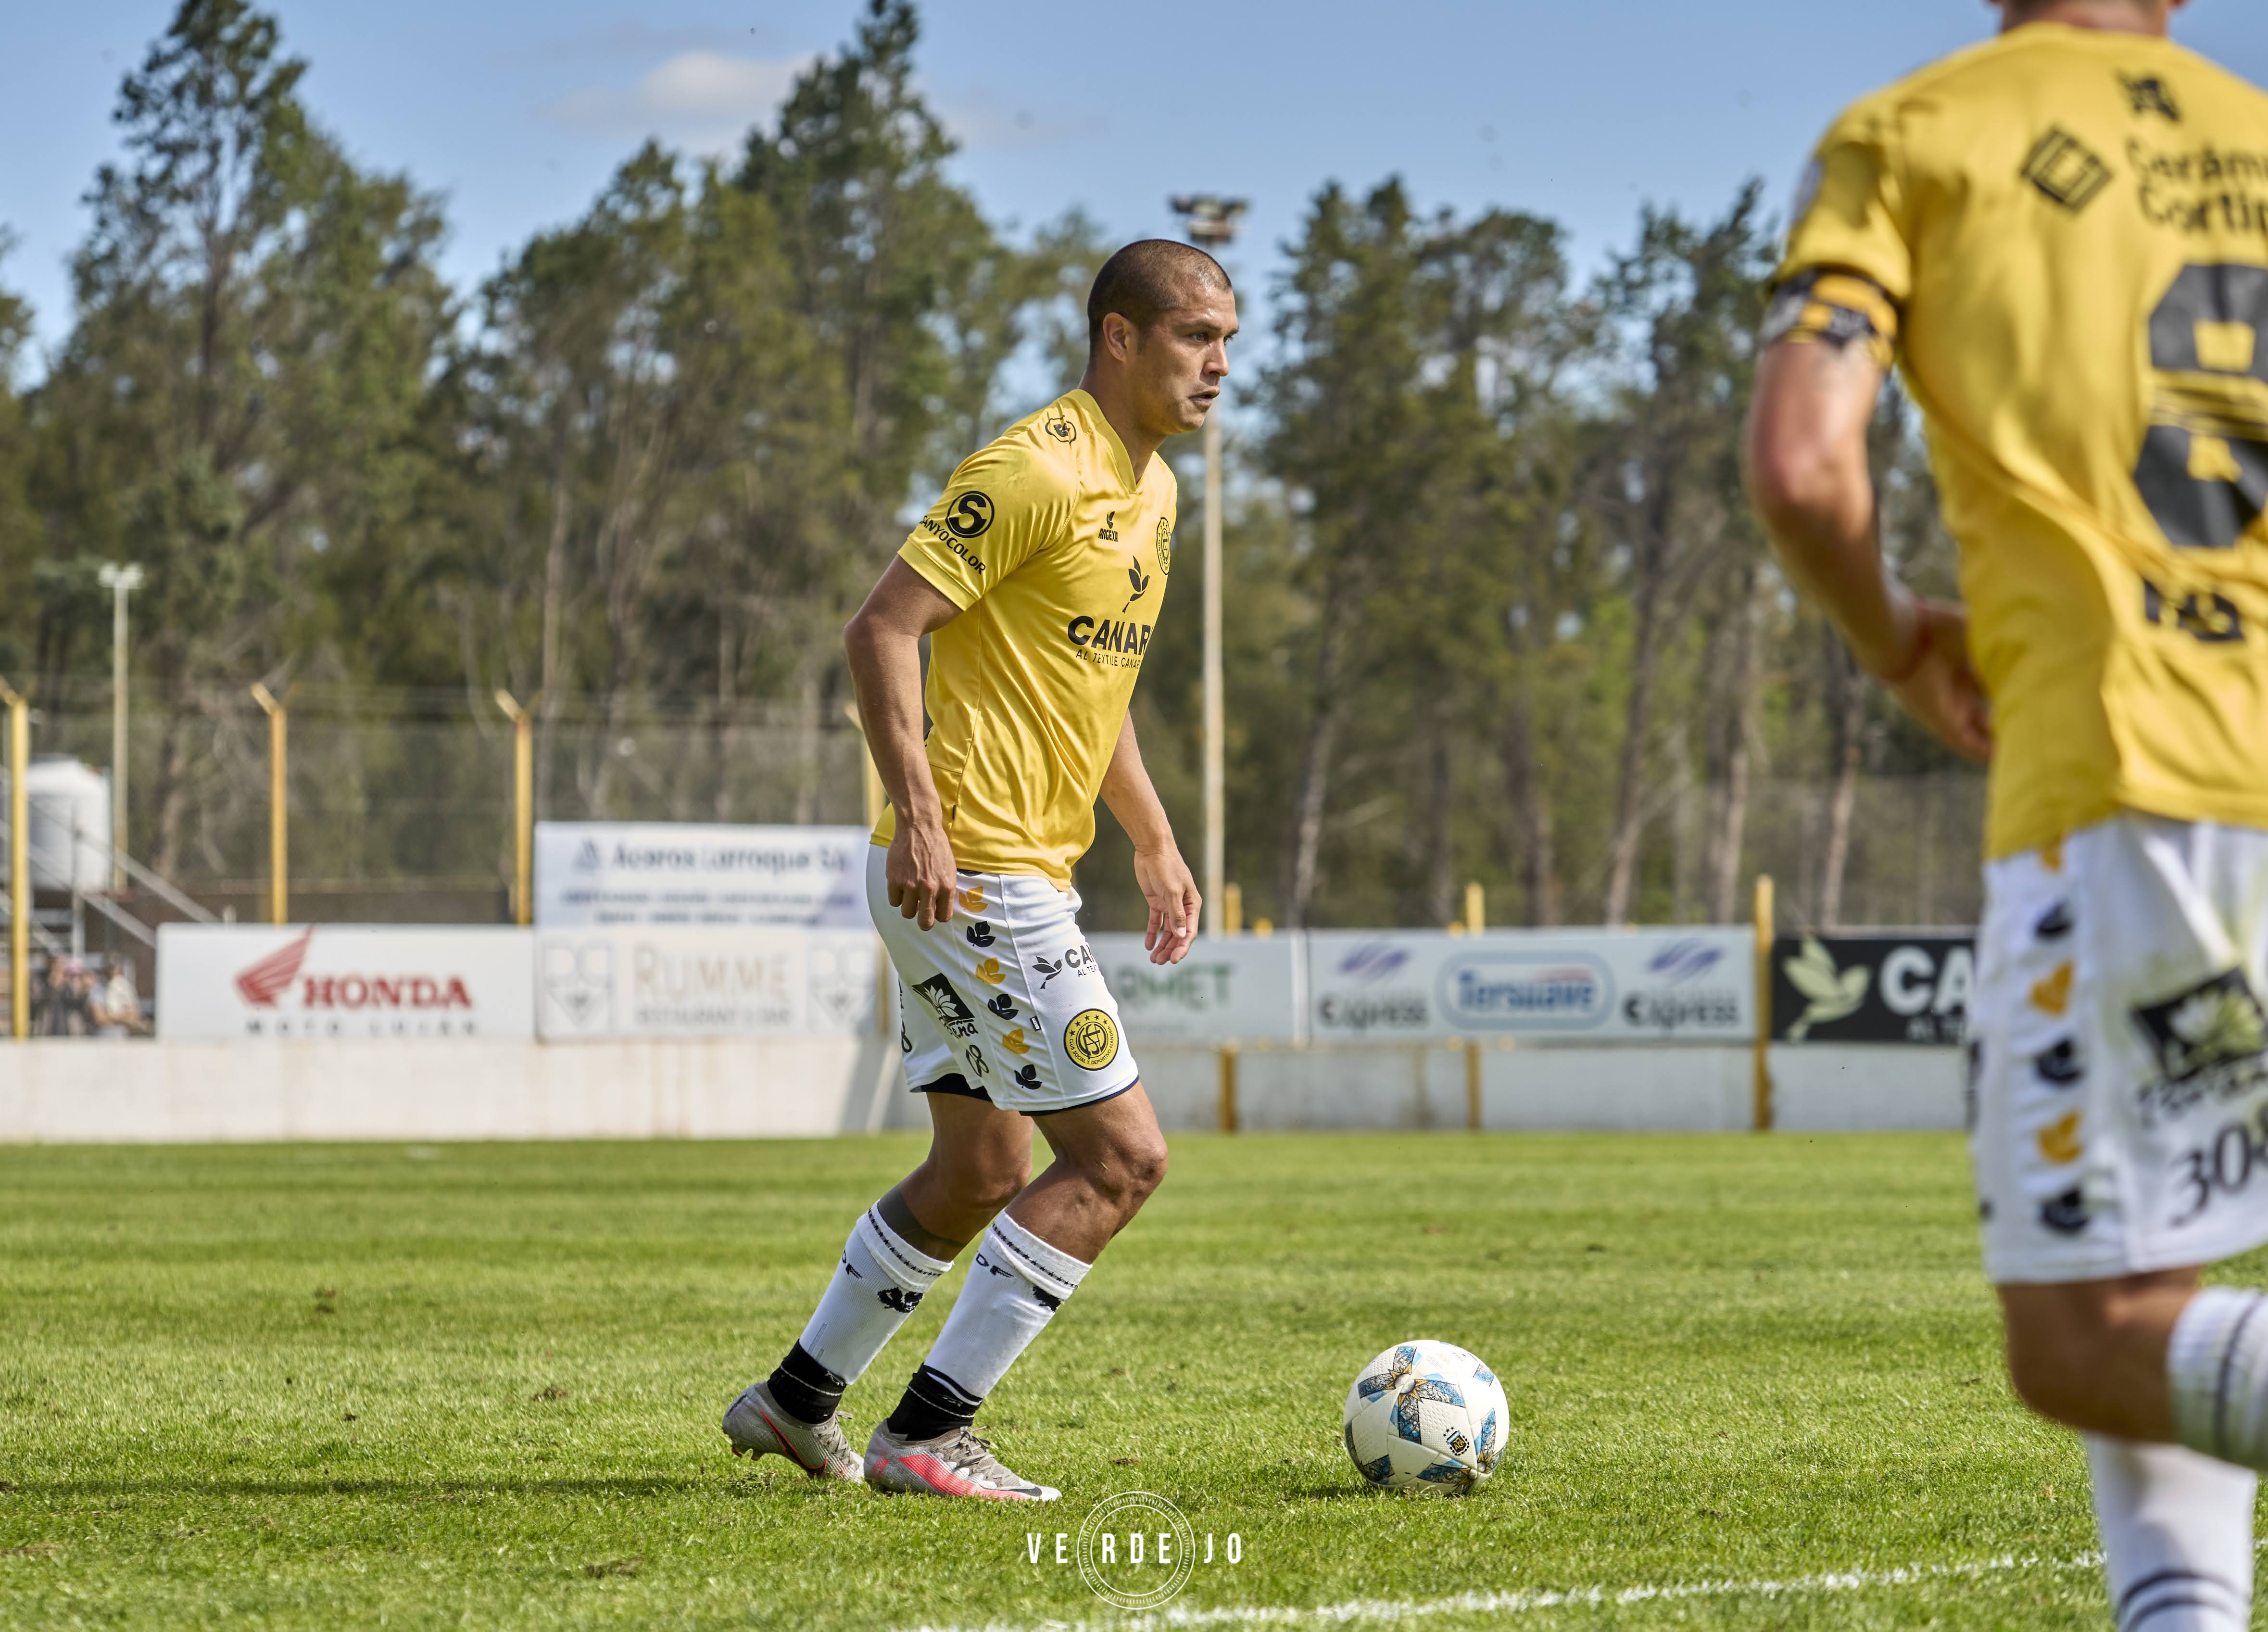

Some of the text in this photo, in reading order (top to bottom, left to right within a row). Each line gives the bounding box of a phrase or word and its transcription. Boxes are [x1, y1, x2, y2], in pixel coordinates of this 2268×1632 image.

[1068, 615, 1154, 656] CANAR
[1076, 649, 1088, 660] AL
[1092, 653, 1118, 667] TEXTILE
[1065, 944, 1095, 968] CA
[1078, 968, 1087, 977] AL
[303, 975, 473, 1009] HONDA
[1073, 1050, 1086, 1063] SOCIAL
[1091, 1049, 1111, 1065] DEPORTIVO
